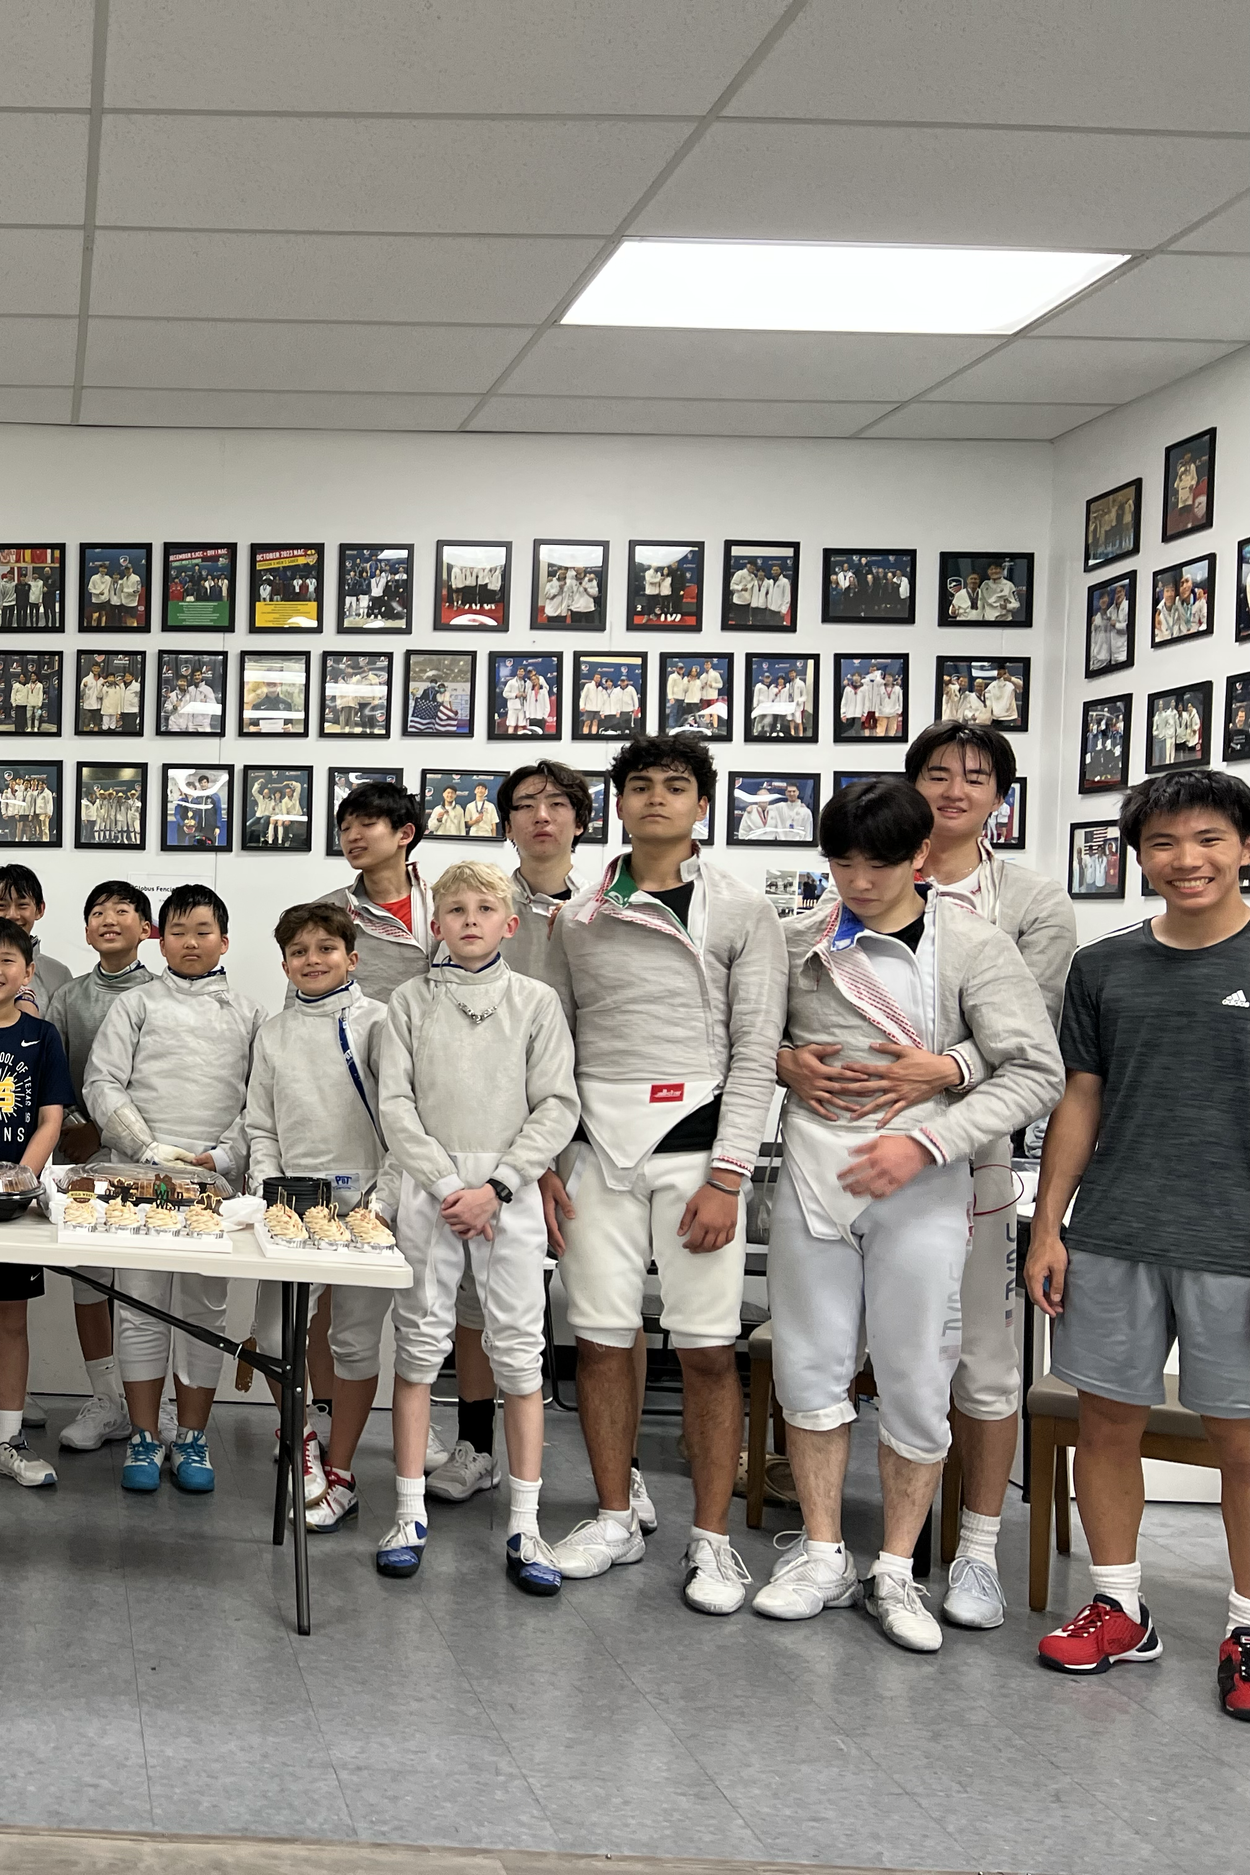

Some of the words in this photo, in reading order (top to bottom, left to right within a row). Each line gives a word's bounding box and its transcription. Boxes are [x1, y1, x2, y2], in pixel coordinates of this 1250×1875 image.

[256, 551, 280, 561] OCTOBER
[15, 1061, 29, 1074] OF
[23, 1076, 32, 1106] TEXAS
